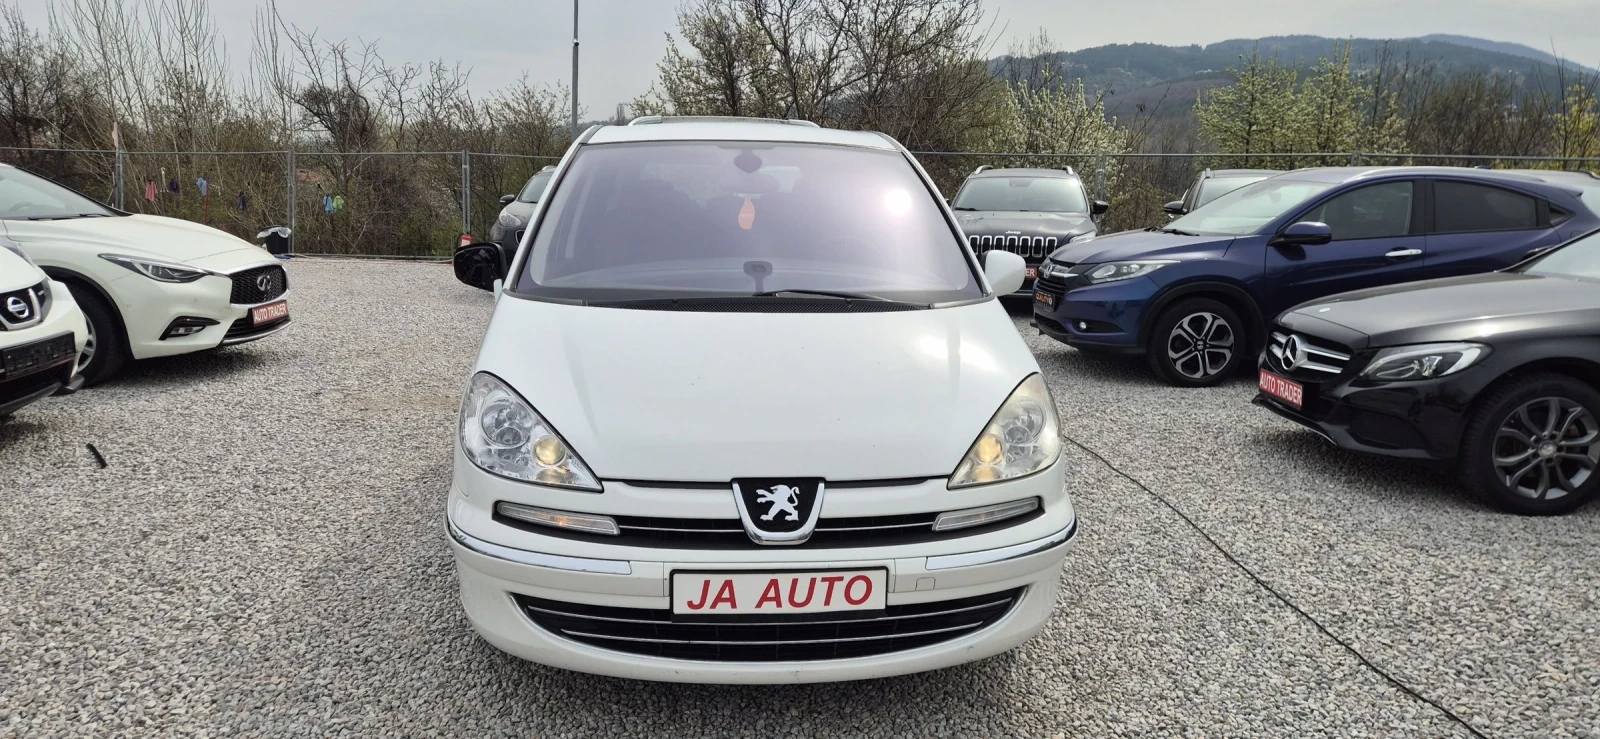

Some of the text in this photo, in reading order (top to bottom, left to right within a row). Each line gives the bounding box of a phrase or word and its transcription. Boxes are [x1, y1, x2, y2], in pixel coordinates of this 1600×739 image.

[1025, 268, 1035, 277] ER
[254, 303, 287, 322] AUTO TRADER
[1260, 372, 1302, 405] AUTO TRADER
[686, 575, 873, 610] JA AUTO
